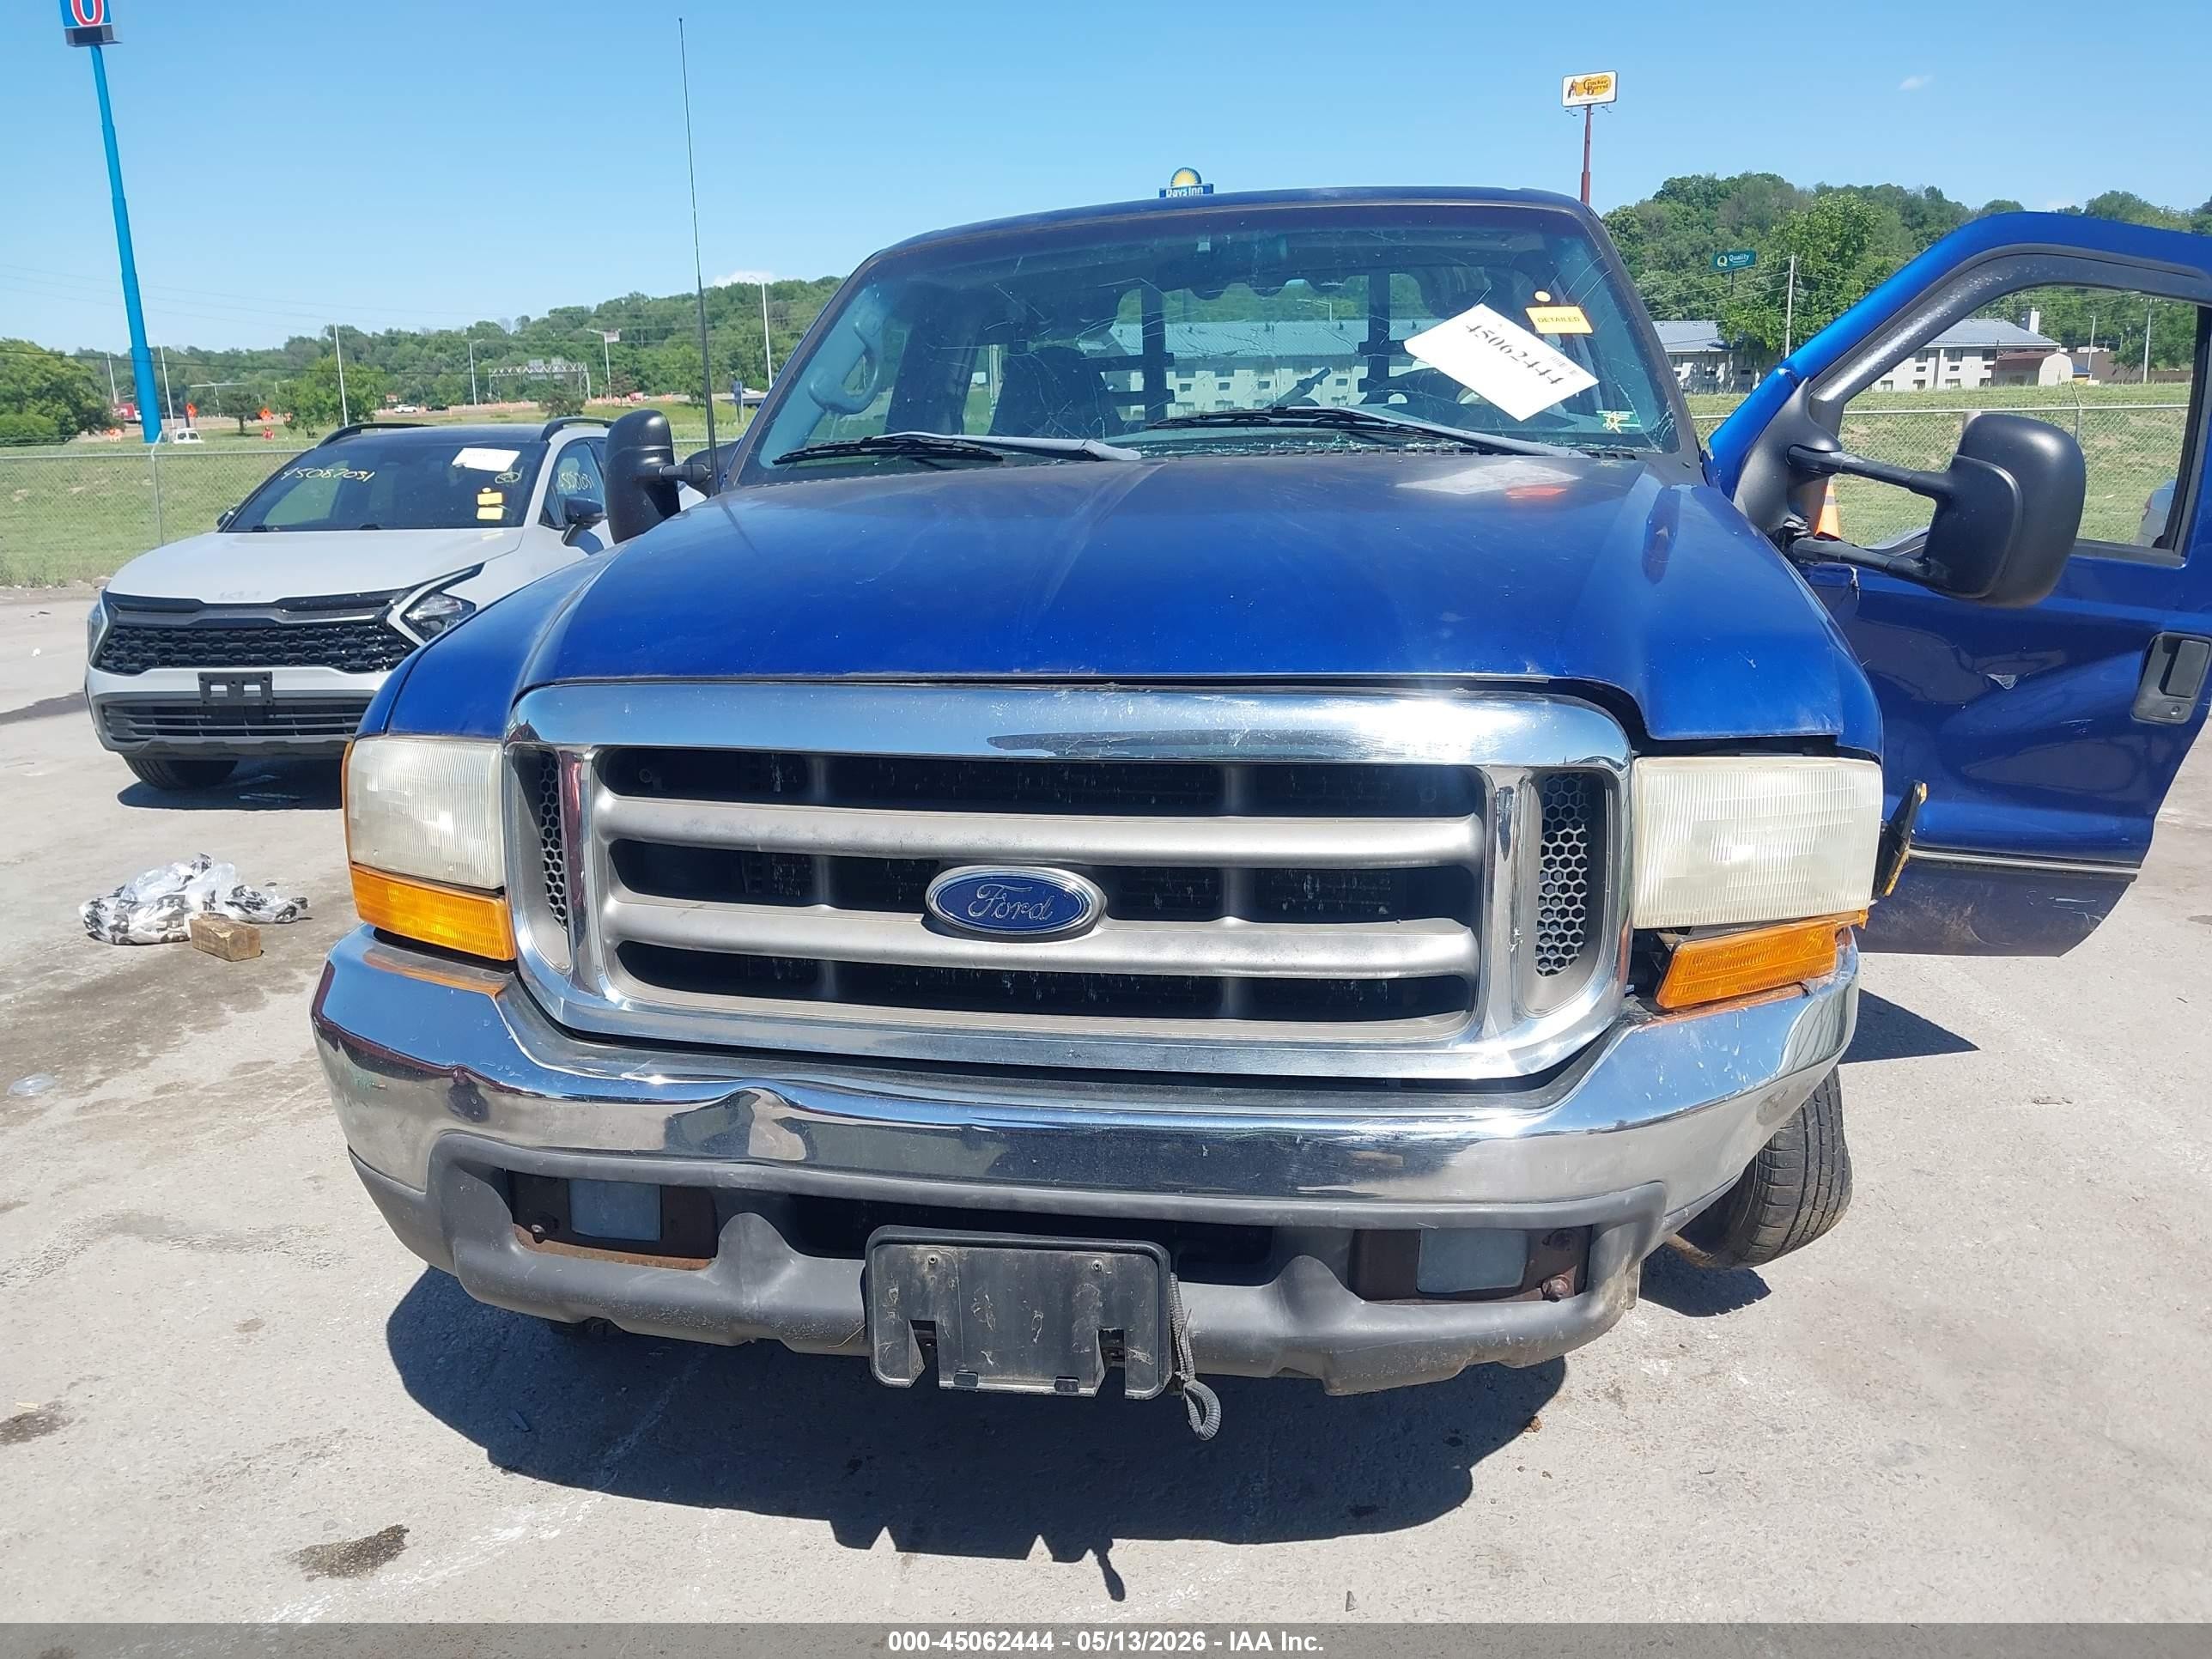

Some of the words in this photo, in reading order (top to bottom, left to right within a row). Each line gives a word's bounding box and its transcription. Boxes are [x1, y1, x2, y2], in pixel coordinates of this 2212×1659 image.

[1188, 185, 1203, 196] Inn
[1729, 253, 1750, 262] Quality
[1466, 325, 1565, 384] 45062444
[968, 883, 1054, 921] Ford
